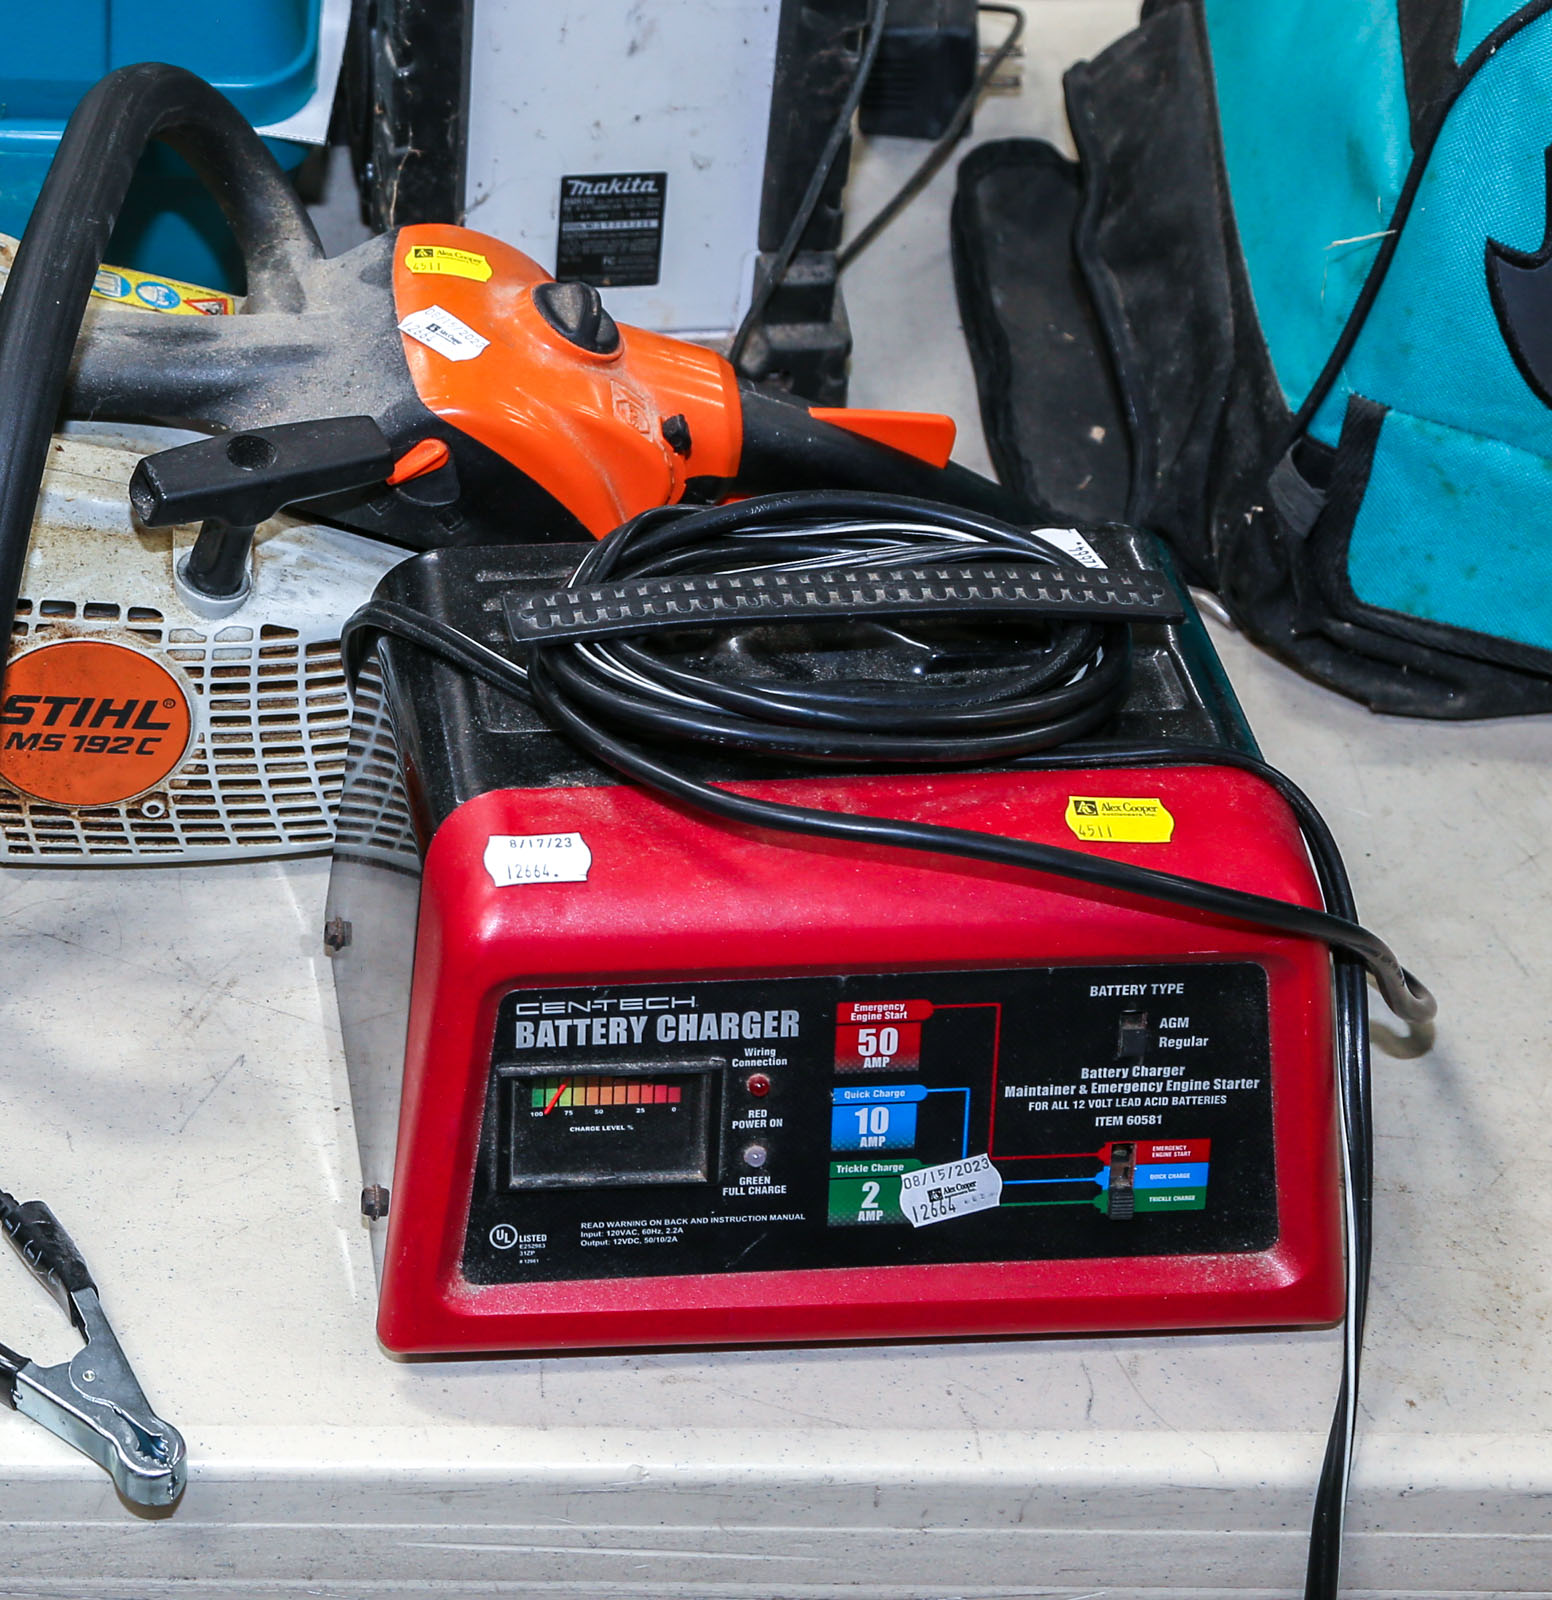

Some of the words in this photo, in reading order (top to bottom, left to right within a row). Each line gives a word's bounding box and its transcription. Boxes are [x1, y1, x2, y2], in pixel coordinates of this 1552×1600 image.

[0, 694, 171, 731] STIHL
[3, 732, 67, 752] MS
[72, 734, 136, 754] 192
[135, 737, 163, 756] C
[1101, 802, 1122, 812] Alex
[1122, 802, 1158, 814] Cooper
[1078, 823, 1113, 838] 4511
[509, 837, 573, 849] 8/17/23
[1089, 984, 1147, 997] BATTERY
[1150, 983, 1185, 995] TYPE
[853, 1003, 906, 1012] Emergency
[850, 1012, 883, 1022] Engine
[884, 1010, 908, 1020] Start
[515, 1015, 649, 1049] BATTERY
[655, 1009, 800, 1043] CHARGER
[1159, 1017, 1190, 1029] AGM
[857, 1026, 899, 1057] 50
[1158, 1036, 1209, 1049] Regular
[743, 1048, 777, 1057] Wiring
[731, 1057, 788, 1068] Connection
[863, 1056, 891, 1069] AMP
[1080, 1067, 1129, 1081] Battery
[1131, 1065, 1186, 1079] Charger
[844, 1089, 871, 1099] Quick
[872, 1089, 906, 1099] Charge
[1004, 1083, 1077, 1098] Maintainer
[1078, 1083, 1089, 1095] &
[1090, 1081, 1163, 1096] Emergency
[1165, 1079, 1210, 1093] Engine
[1212, 1077, 1261, 1090] Starter
[1028, 1100, 1049, 1112] FOR
[1050, 1099, 1070, 1110] ALL
[1072, 1099, 1086, 1110] 12
[1087, 1098, 1113, 1109] VOLT
[1115, 1097, 1142, 1108] LEAD
[1143, 1096, 1169, 1107] ACID
[1170, 1094, 1228, 1106] BATTERIES
[747, 1109, 768, 1119] RED
[854, 1106, 890, 1135] 10
[1094, 1115, 1124, 1127] ITEM
[1125, 1114, 1163, 1126] 60581
[569, 1125, 601, 1133] CHARGE
[601, 1124, 626, 1132] LEVEL
[731, 1119, 767, 1130] POWER
[769, 1118, 783, 1128] ON
[859, 1135, 887, 1148] AMP
[1173, 1150, 1192, 1158] START
[836, 1164, 870, 1174] Trickle
[870, 1163, 905, 1174] Charge
[903, 1157, 990, 1190] 08/15/2023
[738, 1176, 771, 1186] GREEN
[1167, 1172, 1191, 1180] CHARGE
[722, 1186, 746, 1196] FULL
[747, 1185, 787, 1195] CHARGE
[943, 1185, 957, 1195] Alex
[956, 1181, 977, 1194] Cooper
[860, 1181, 881, 1209] 2
[1149, 1195, 1172, 1203] TRICKLE
[1172, 1194, 1196, 1202] CHARGE
[857, 1210, 884, 1222] AMP
[911, 1198, 957, 1223] 12664
[580, 1221, 605, 1229] READ
[606, 1219, 648, 1229] WARNING
[649, 1218, 663, 1227] ON
[664, 1217, 689, 1226] BACK
[690, 1216, 709, 1225] AND
[710, 1214, 768, 1224] INSTRUCTION
[769, 1212, 806, 1222] MANUAL
[496, 1229, 512, 1244] UL
[518, 1233, 548, 1243] LISTED
[580, 1230, 604, 1239] Input:
[606, 1228, 641, 1238] 120VAC,
[641, 1227, 664, 1237] 60Hz,
[665, 1226, 684, 1236] 2.2A
[580, 1238, 611, 1248] Output:
[613, 1237, 642, 1246] 12VDC,
[643, 1235, 678, 1245] 50/10/2A
